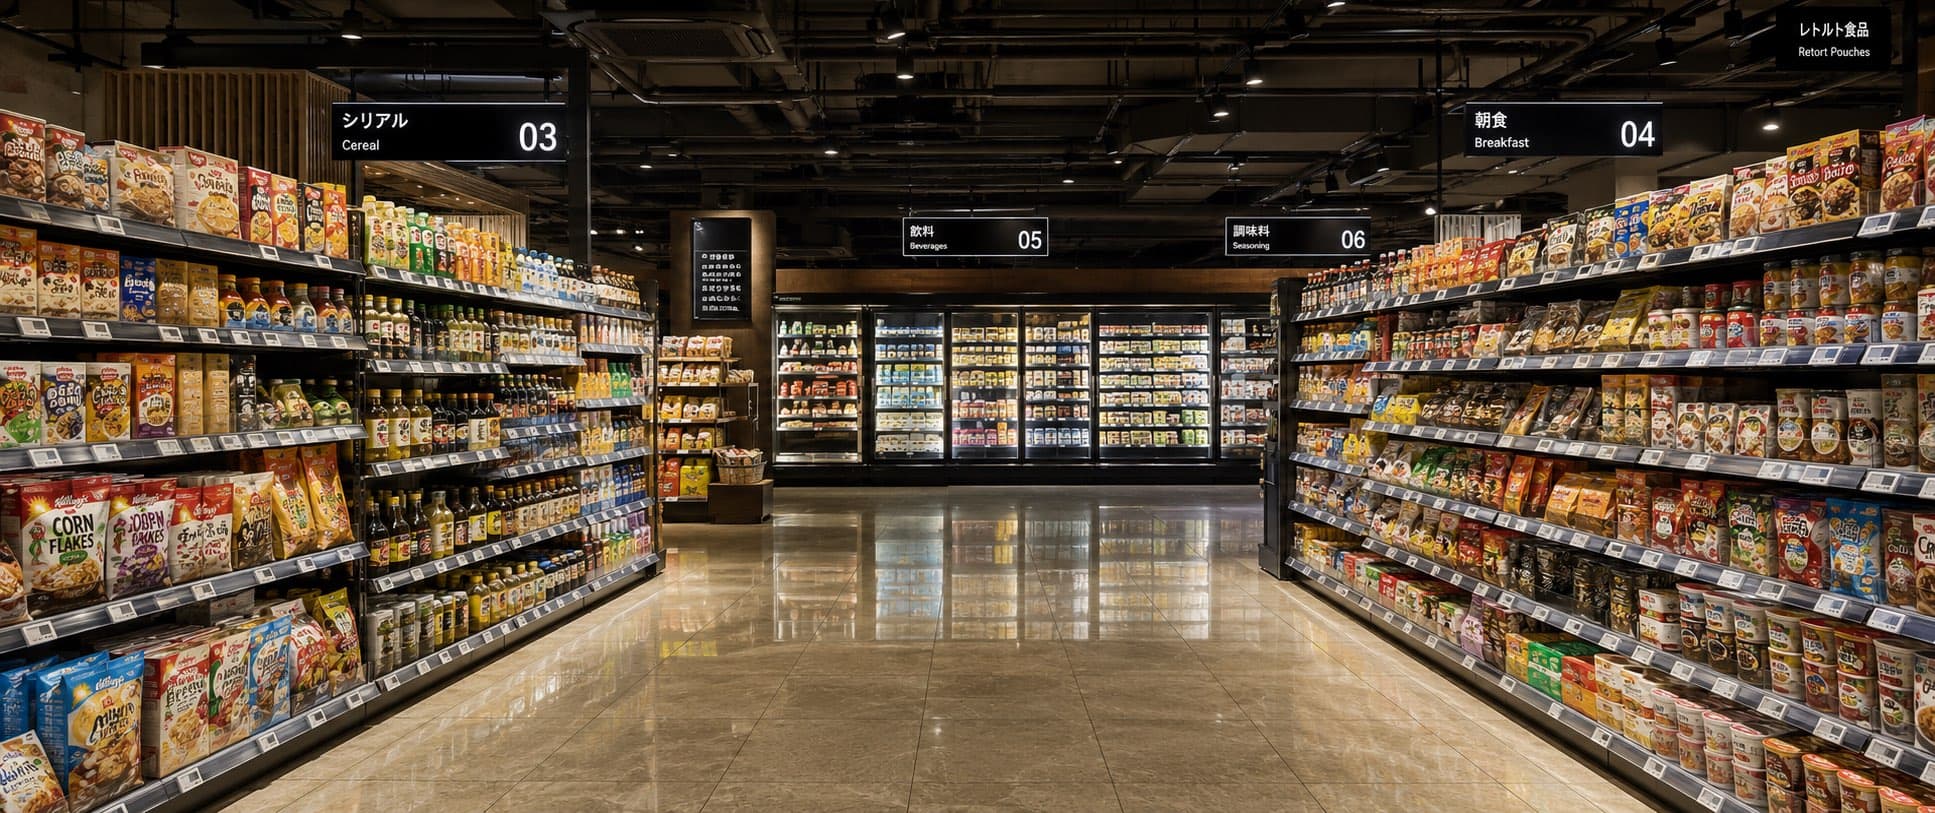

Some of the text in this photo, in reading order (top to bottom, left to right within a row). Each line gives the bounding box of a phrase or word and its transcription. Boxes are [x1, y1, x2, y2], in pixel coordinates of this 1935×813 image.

[1800, 21, 1869, 38] レトルト食品
[1798, 46, 1871, 57] Retort Pouches
[342, 112, 409, 129] シリアル
[1474, 111, 1508, 129] 朝食
[519, 121, 557, 152] 03
[1474, 136, 1530, 149] Breakfast
[1620, 120, 1656, 148] 04
[342, 139, 380, 151] Cereal
[910, 224, 935, 238] 飲料
[1233, 224, 1270, 238] 調味料
[1341, 230, 1365, 249] 06
[909, 241, 948, 252] Beverages
[1018, 230, 1042, 250] 05
[1232, 241, 1270, 251] Seasoning
[52, 513, 95, 537] CORN
[49, 533, 94, 554] FLAKES
